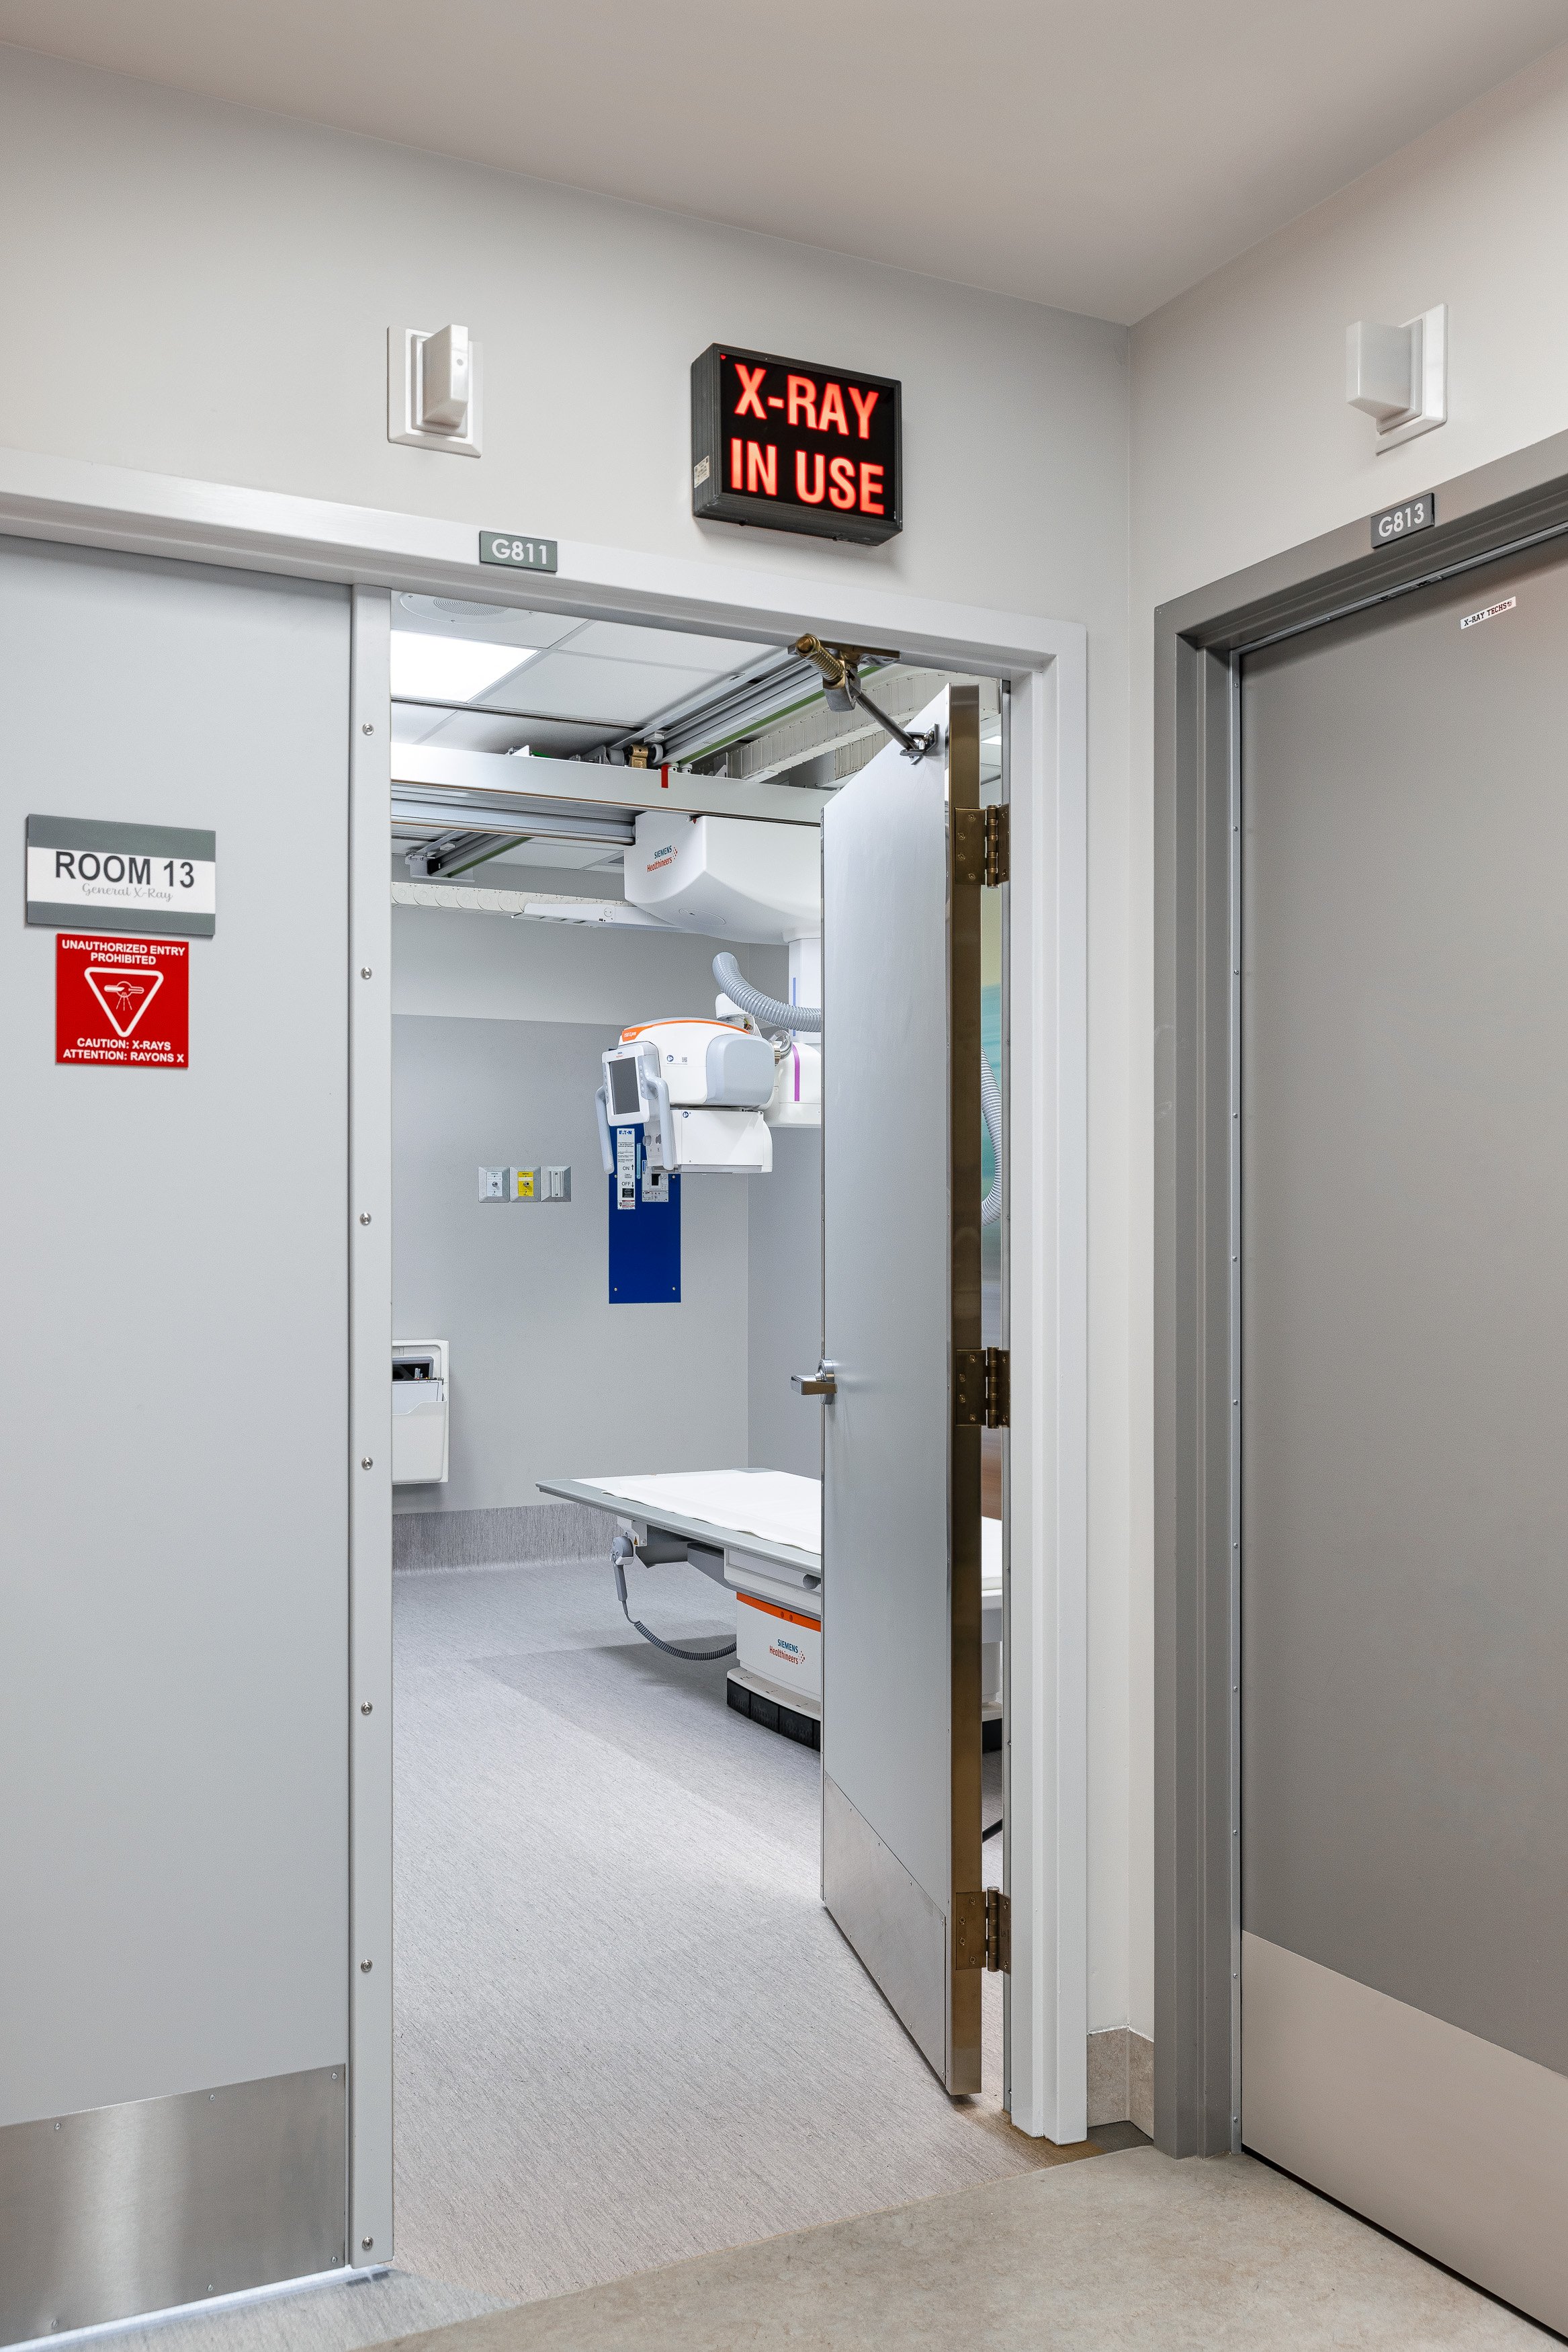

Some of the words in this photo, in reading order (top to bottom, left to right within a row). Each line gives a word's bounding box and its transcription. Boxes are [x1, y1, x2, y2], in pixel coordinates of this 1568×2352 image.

[734, 364, 879, 439] X-RAY
[731, 437, 777, 496] IN
[795, 450, 884, 515] USE
[1378, 503, 1424, 538] G813
[492, 538, 547, 564] G811
[1464, 612, 1485, 626] X-RAY
[1487, 602, 1507, 616] TECHS
[654, 845, 672, 859] SIEMENS
[55, 851, 151, 886] ROOM
[163, 860, 195, 888] 13
[647, 857, 672, 872] Healthineers
[82, 882, 131, 896] General
[134, 886, 173, 902] X-Ray
[62, 939, 148, 954] UNAUTHORIZED
[150, 945, 185, 956] ENTRY
[91, 952, 157, 965] PROHIBITED
[77, 1038, 130, 1049] CAUTION:
[132, 1040, 171, 1050] X-RAYS
[62, 1049, 128, 1060] ATTENTION:
[130, 1052, 175, 1062] RAYONS
[177, 1054, 185, 1063] X
[769, 1645, 799, 1665] Healthineers
[777, 1639, 799, 1654] SIEMENS
